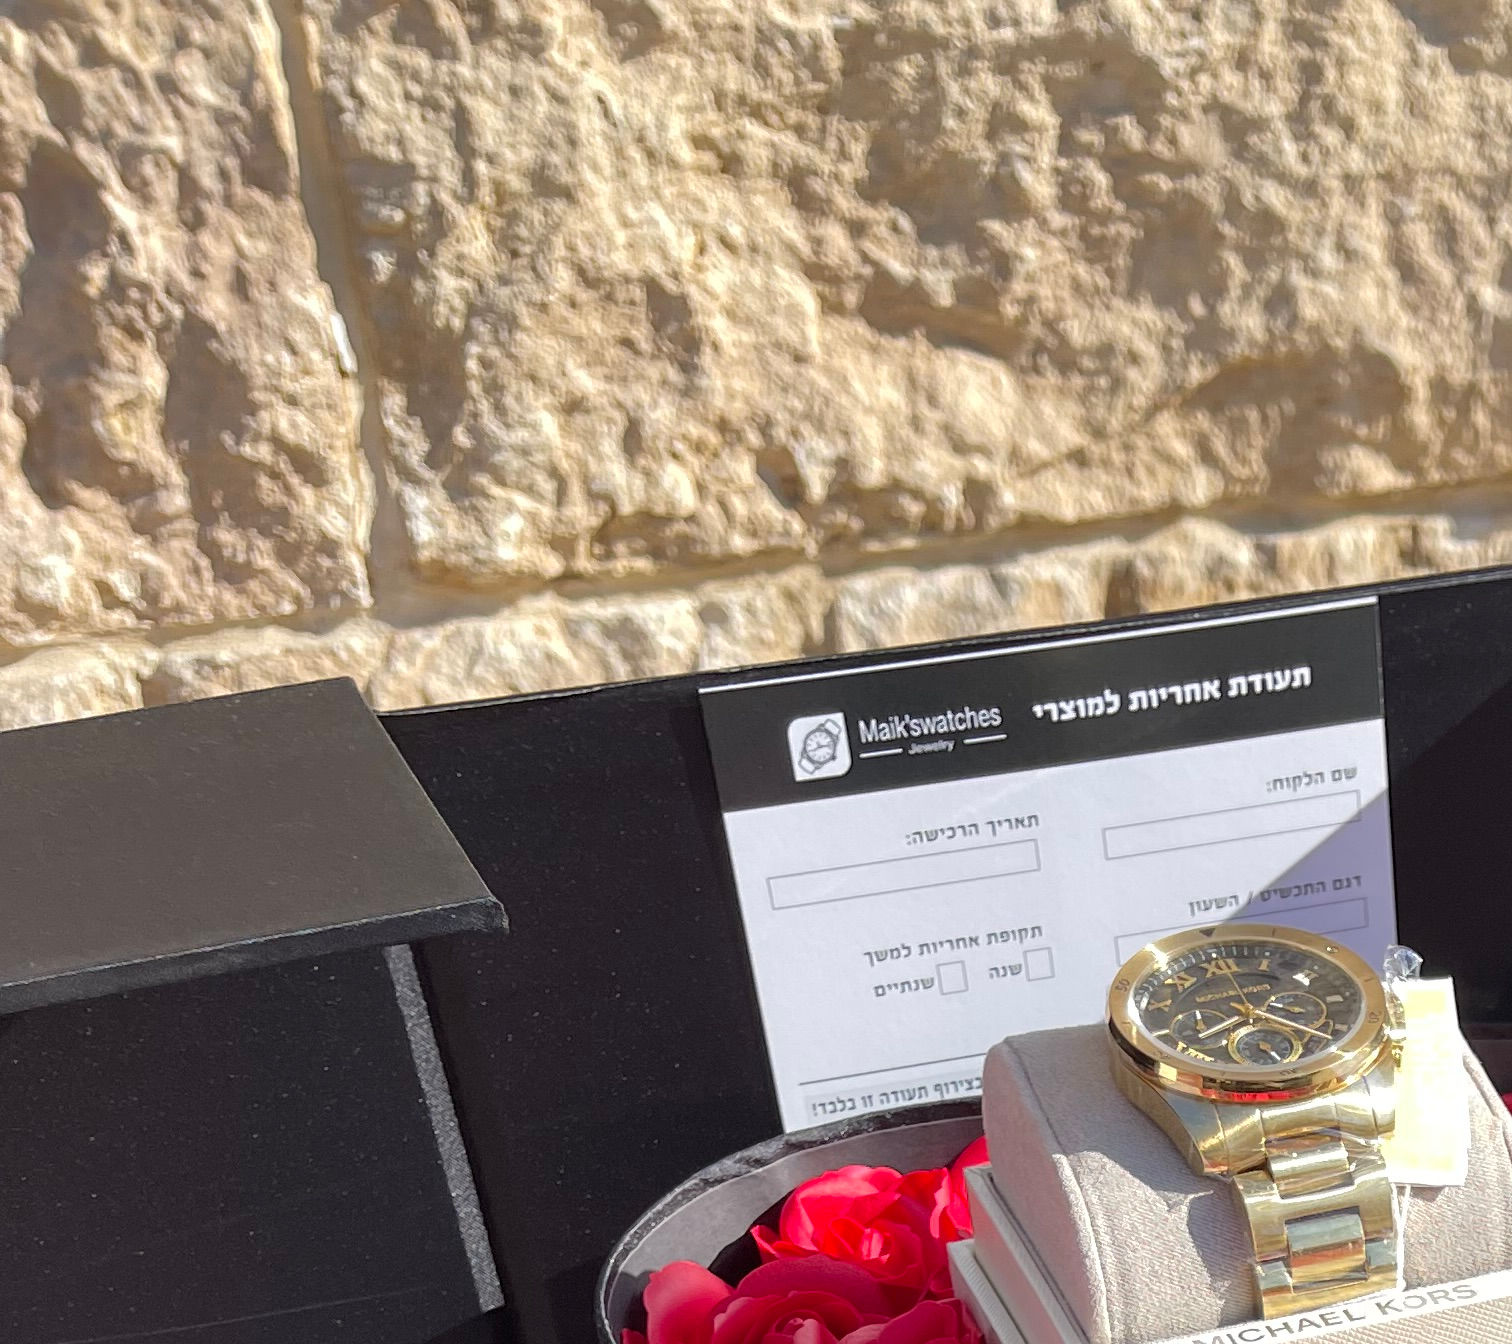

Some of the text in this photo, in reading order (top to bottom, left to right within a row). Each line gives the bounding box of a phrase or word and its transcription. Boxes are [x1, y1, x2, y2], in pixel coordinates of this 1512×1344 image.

[1031, 664, 1312, 722] תעודת אחריות למוצרי
[858, 706, 1002, 744] Maik'swatches
[905, 814, 1040, 846] תאריך הרכישה:
[863, 925, 1043, 967] תקופת אחריות למשך
[873, 963, 1022, 998] שנה שנתיים
[879, 1085, 929, 1105] תעודה
[1375, 1283, 1479, 1316] KORS
